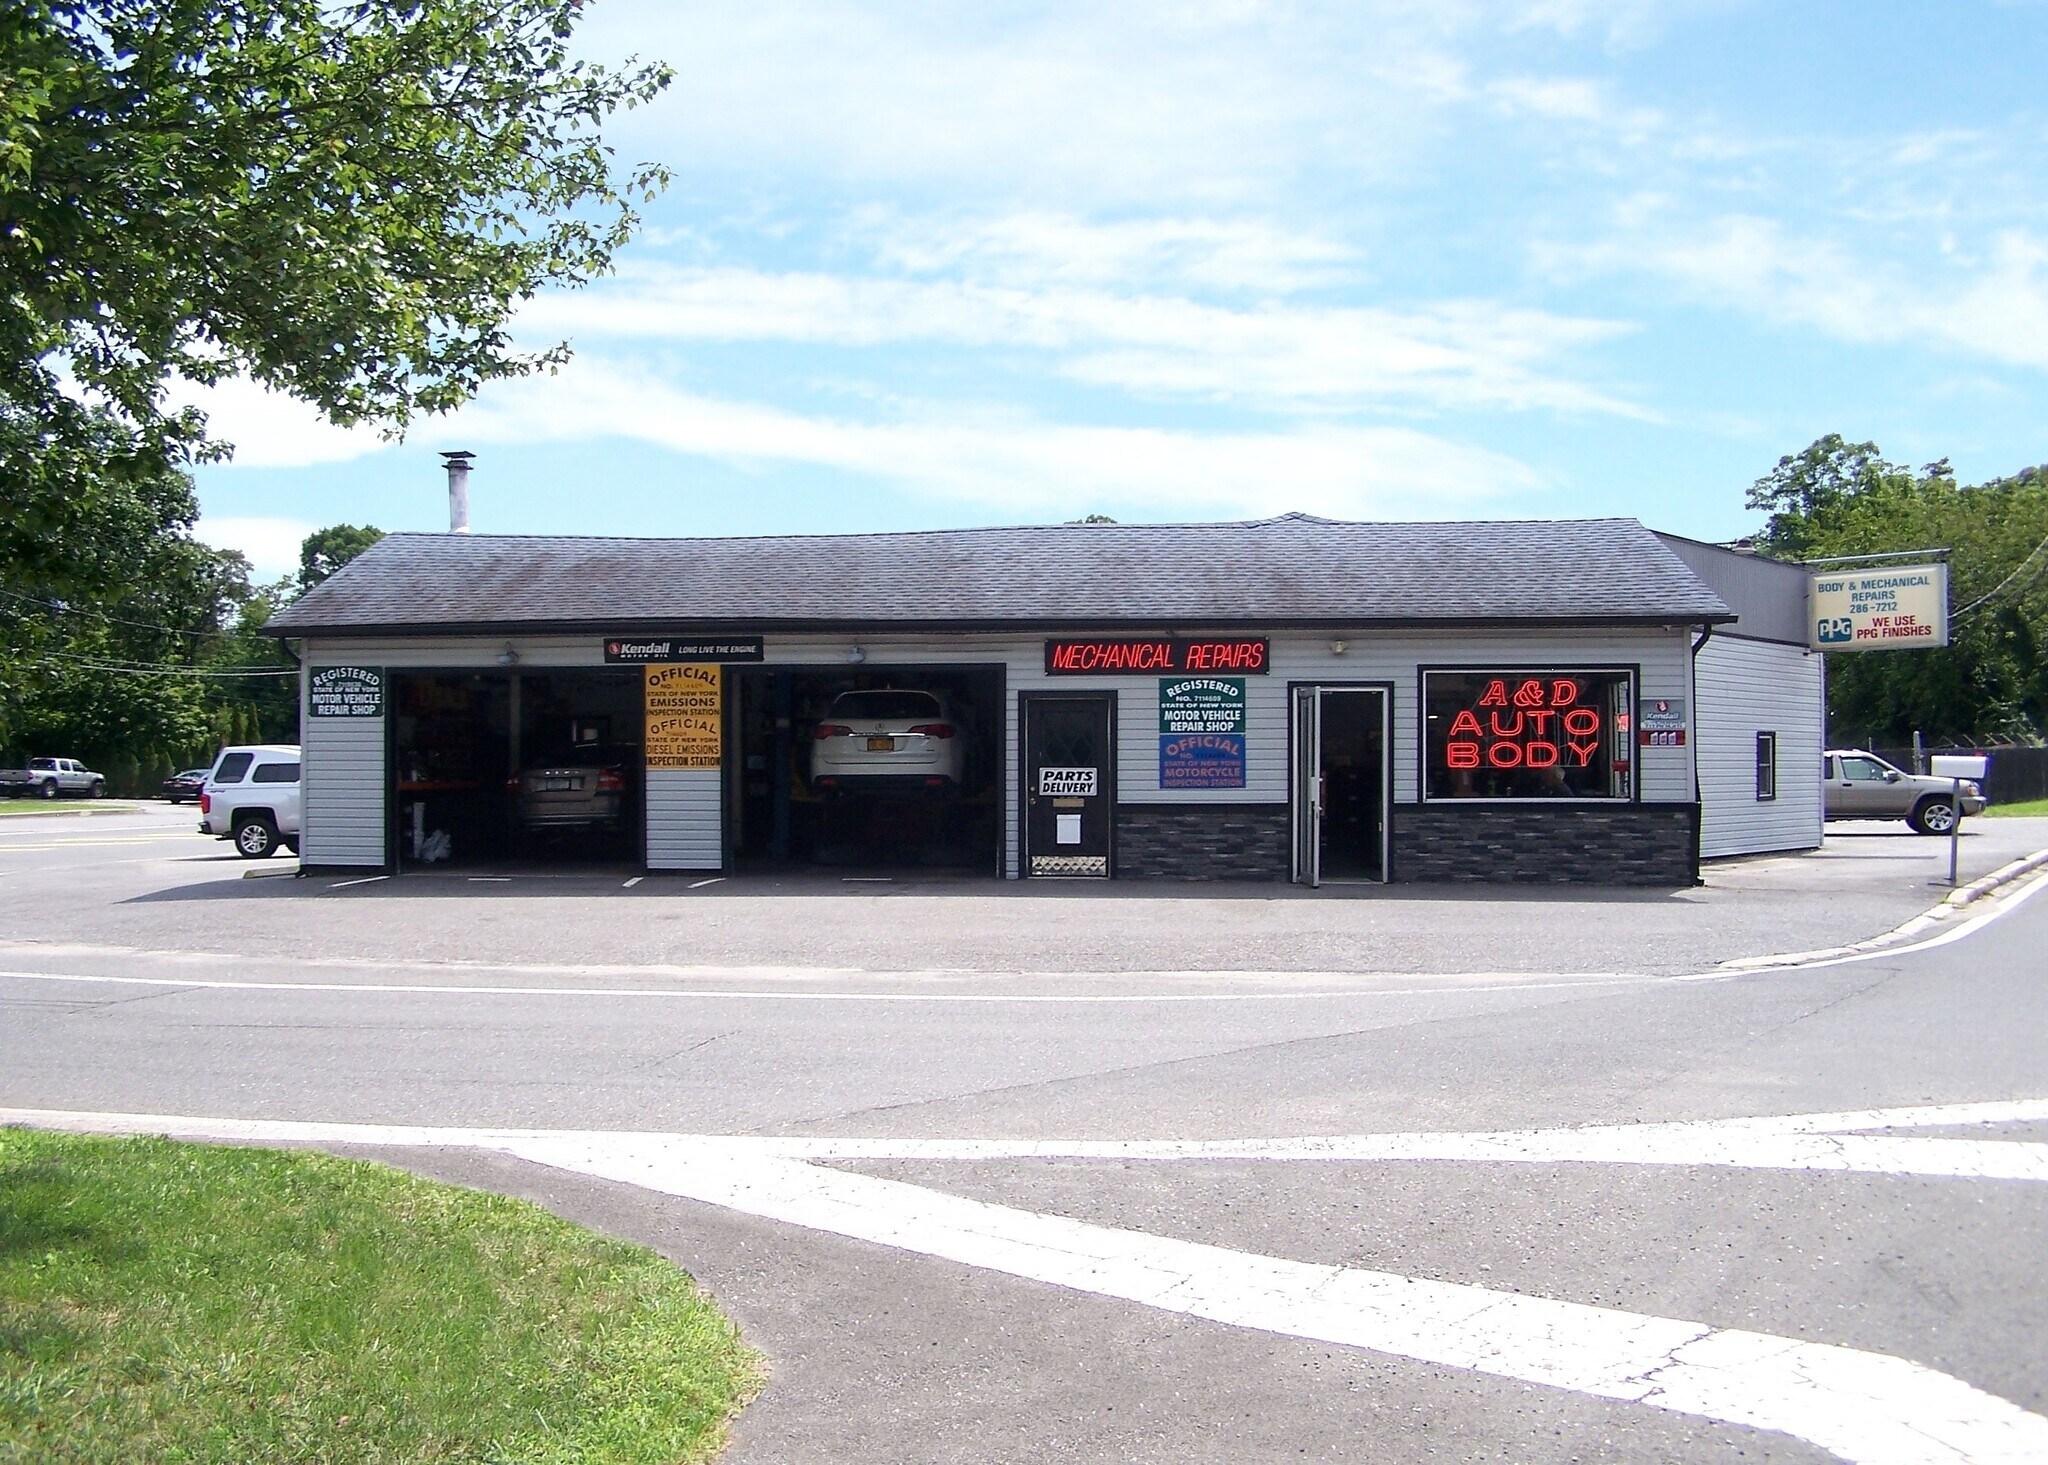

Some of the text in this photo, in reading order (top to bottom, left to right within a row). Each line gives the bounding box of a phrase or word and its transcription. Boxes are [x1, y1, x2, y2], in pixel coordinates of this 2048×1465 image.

[1818, 576, 1929, 593] BODY & MECHANICAL
[1852, 590, 1895, 602] REPAIRS
[1850, 602, 1897, 613] 286-7212
[1872, 615, 1916, 627] WE USE
[1820, 619, 1851, 638] PPG
[1857, 626, 1931, 639] PPG FINISHES
[621, 642, 670, 653] Kendall
[678, 646, 698, 654] LONG
[730, 645, 756, 653] ENGINE
[1052, 643, 1263, 669] MECHANICAL REPAIRS
[313, 668, 380, 686] REGISTERED
[649, 667, 716, 686] OFFICIAL
[1166, 680, 1238, 697] REGISTERED
[1479, 680, 1577, 707] A&D
[312, 694, 381, 703] MOTOR VEHICLE
[651, 698, 715, 706] EMISSIONS
[318, 705, 376, 714] REPAIR SHOP
[1164, 710, 1240, 720] MOTOR VEHICLE
[651, 719, 716, 734] OFFICIAL
[1170, 722, 1234, 731] REPAIR SHOP
[1450, 709, 1599, 736] AUTO
[647, 745, 719, 754] DIESEL EMISSIONS
[1166, 736, 1239, 756] OFFICIAL
[690, 756, 720, 766] STATION
[1447, 742, 1598, 768] BODY
[1043, 771, 1093, 781] PARTS
[1165, 768, 1240, 777] MOTORCYCLE
[1043, 783, 1093, 792] DELIVERY
